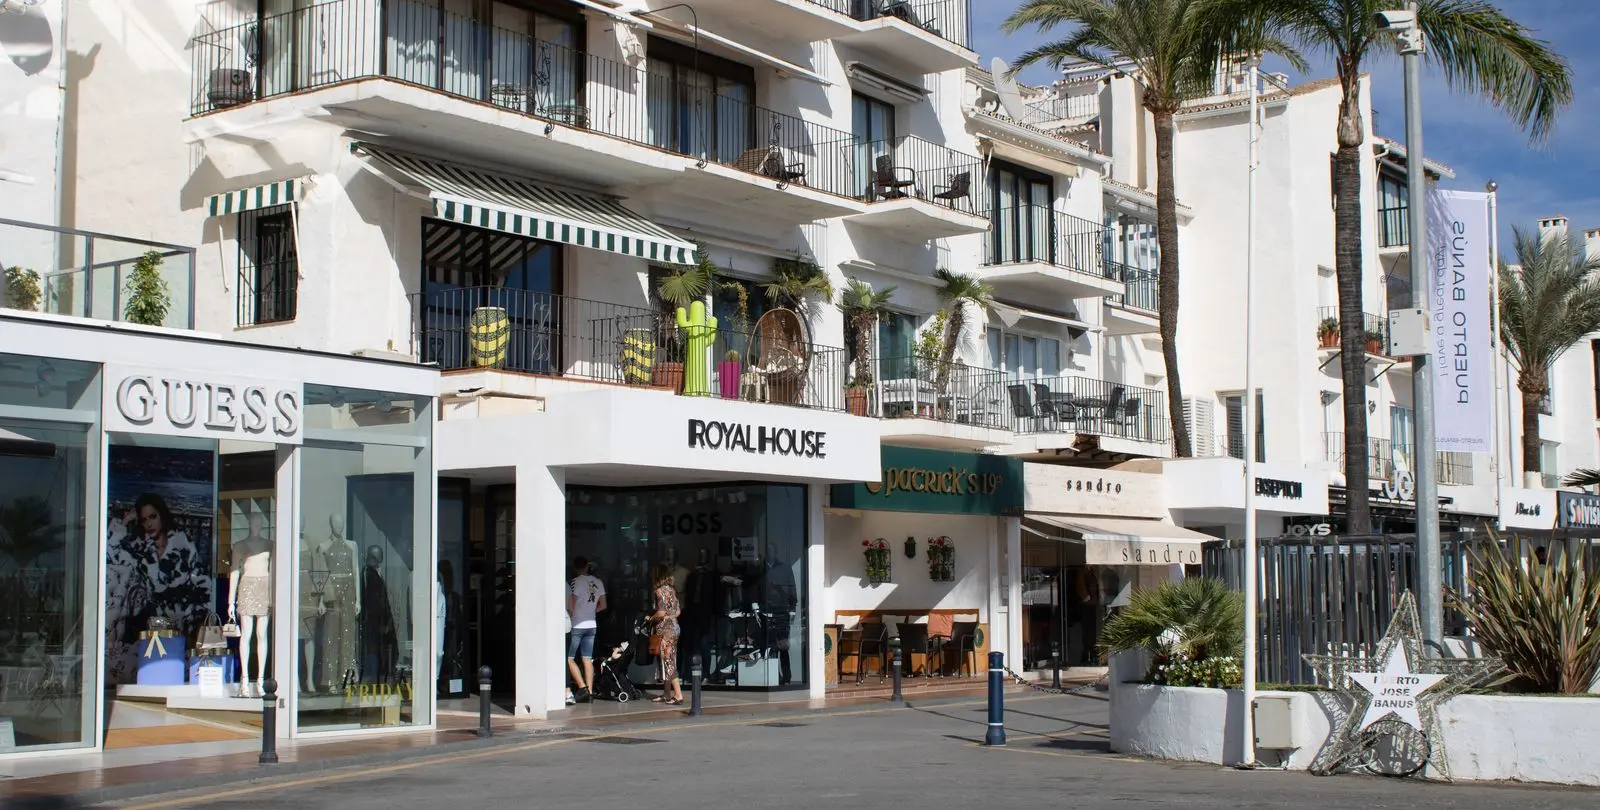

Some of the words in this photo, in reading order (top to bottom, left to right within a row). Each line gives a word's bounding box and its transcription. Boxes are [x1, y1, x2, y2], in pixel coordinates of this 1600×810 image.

[116, 374, 298, 437] GUESS
[688, 418, 756, 453] ROYAL
[758, 426, 826, 458] HOUSE
[1066, 478, 1122, 494] sandro
[661, 511, 723, 535] BOSS
[1122, 544, 1197, 563] sandro
